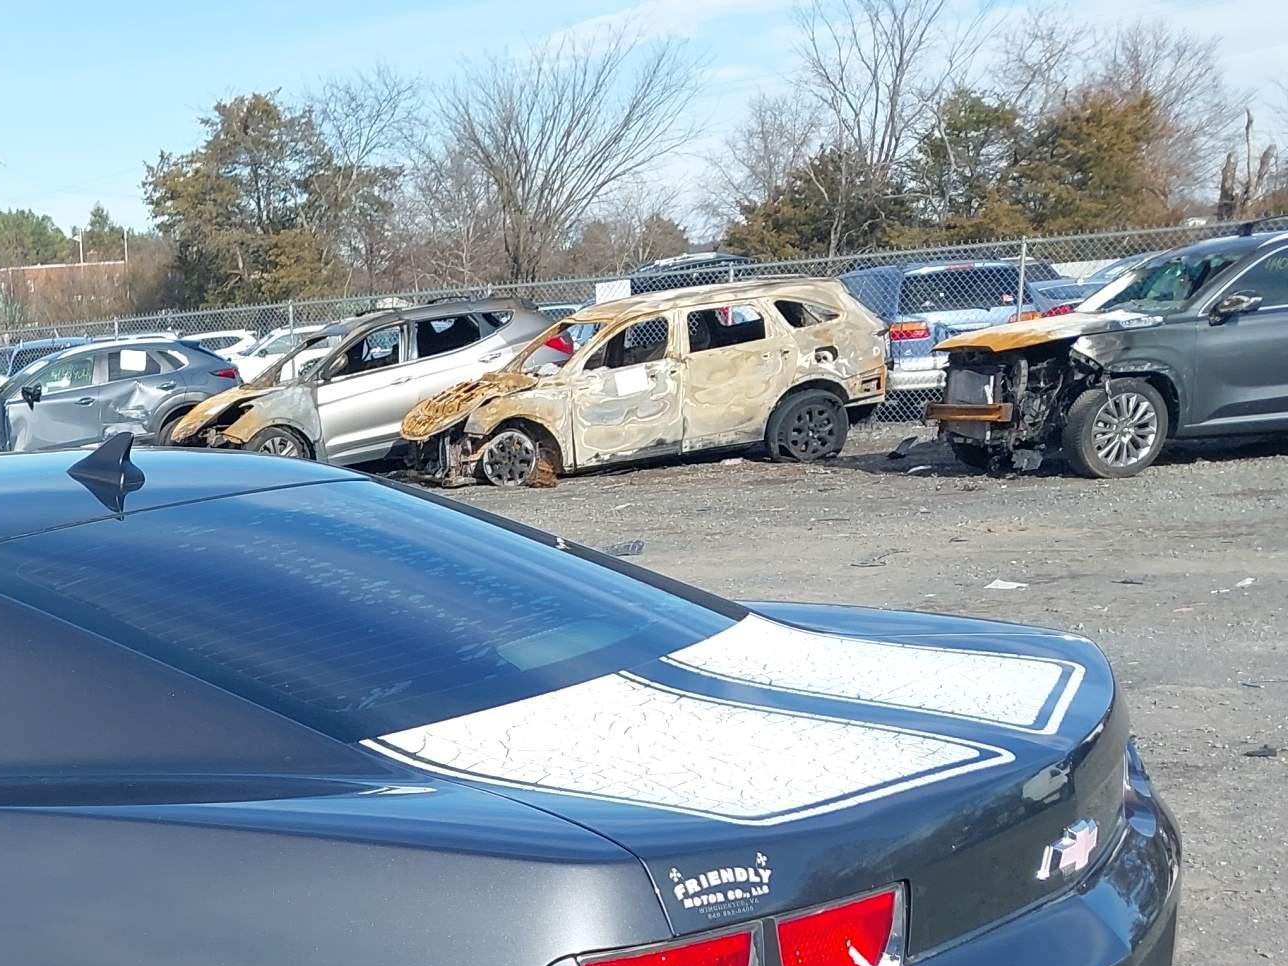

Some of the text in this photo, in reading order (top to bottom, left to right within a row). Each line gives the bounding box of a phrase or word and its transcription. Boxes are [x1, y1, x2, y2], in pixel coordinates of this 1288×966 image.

[673, 867, 772, 901] FRIENDLY
[683, 893, 724, 909] MOTOR
[752, 885, 770, 896] LLC
